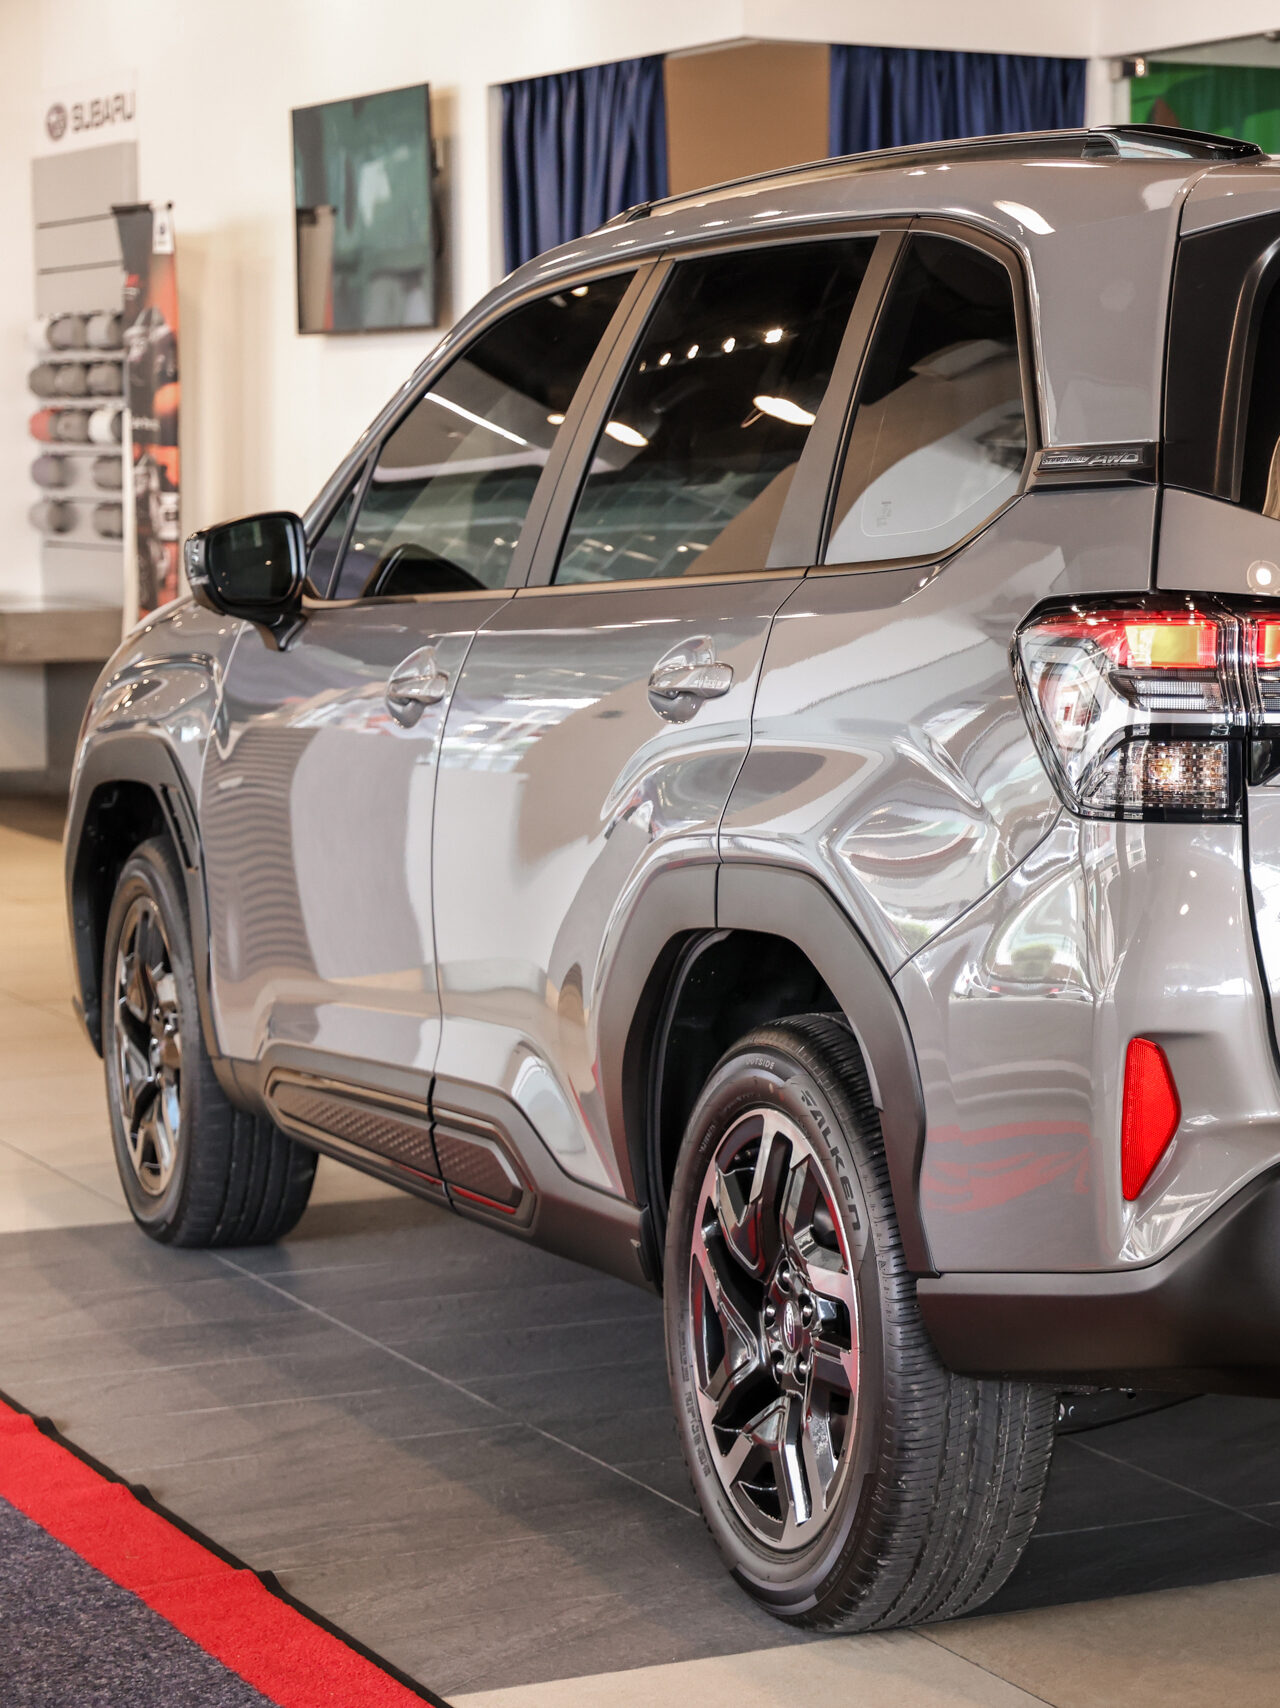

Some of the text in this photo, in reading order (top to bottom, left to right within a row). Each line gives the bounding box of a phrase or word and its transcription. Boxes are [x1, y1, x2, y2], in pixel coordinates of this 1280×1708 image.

[71, 92, 136, 134] SUBARU
[1088, 451, 1139, 465] AWD
[745, 1057, 775, 1070] OUTSIDE
[801, 1089, 861, 1231] FALKEN
